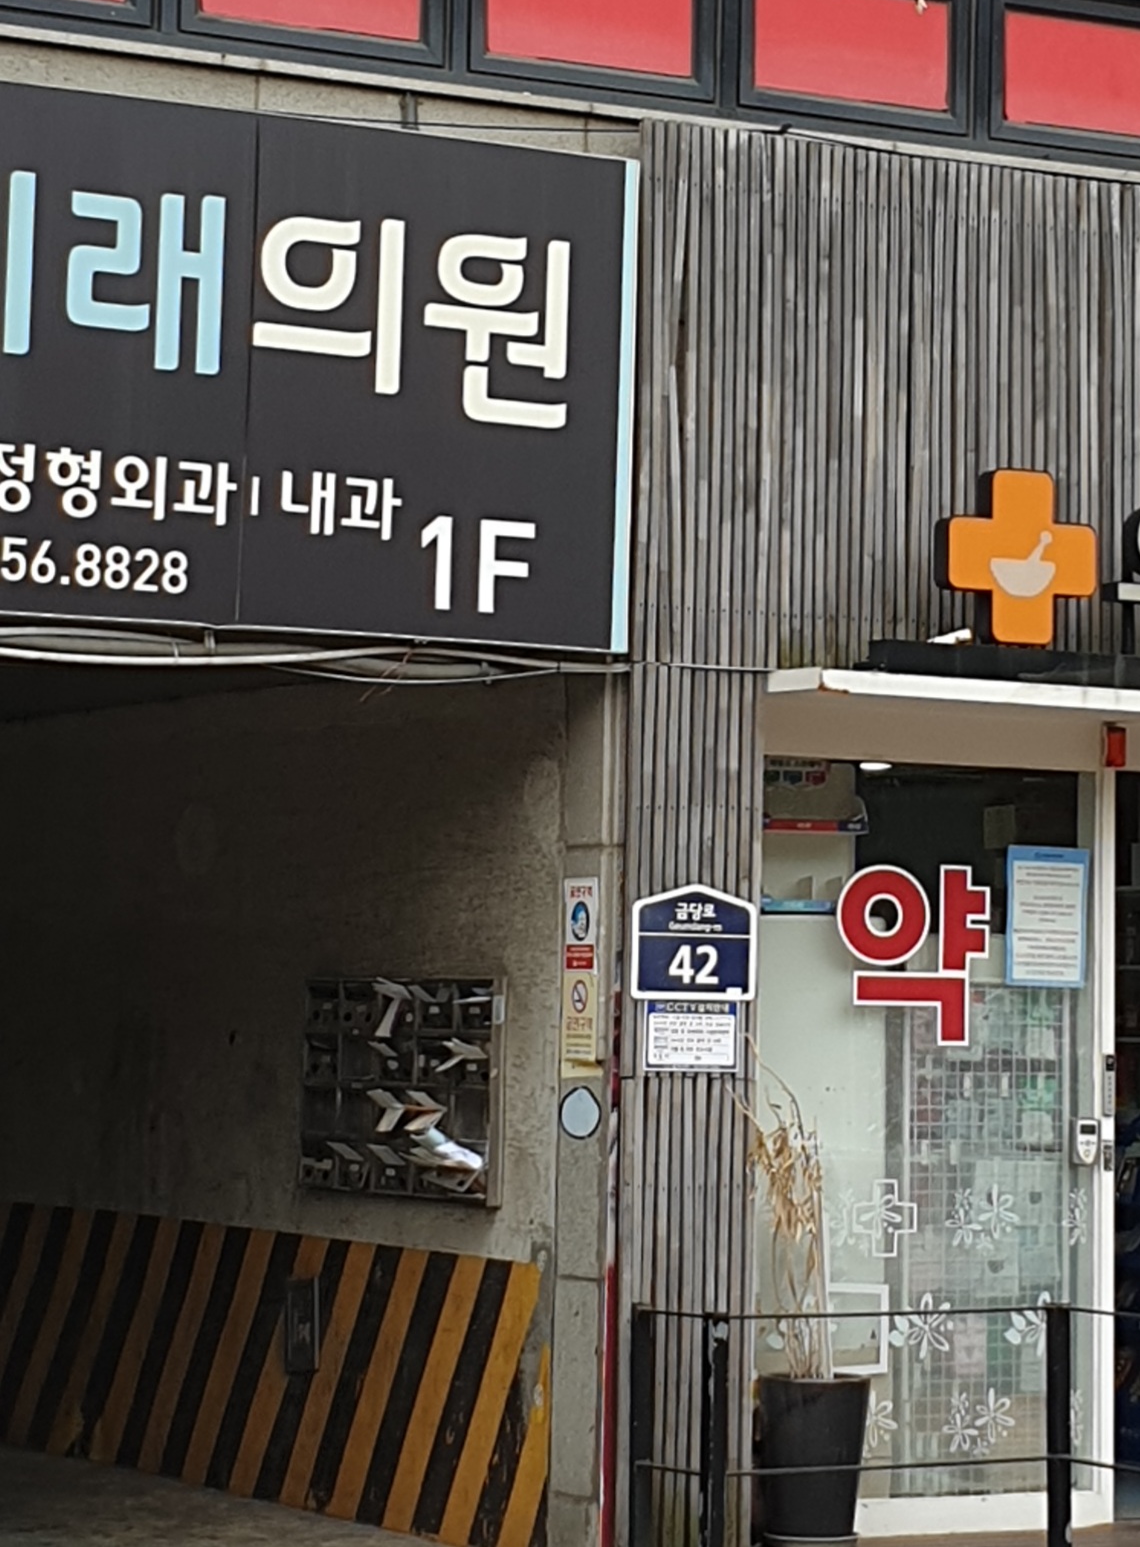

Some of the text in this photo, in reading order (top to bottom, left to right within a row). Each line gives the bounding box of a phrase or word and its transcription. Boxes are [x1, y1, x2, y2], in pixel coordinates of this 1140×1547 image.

[0, 443, 402, 541] 정형외과 내과
[1, 514, 536, 614] 56.8828 1F
[675, 903, 716, 920] 금당로
[837, 864, 990, 1046] 약
[668, 944, 720, 985] 42
